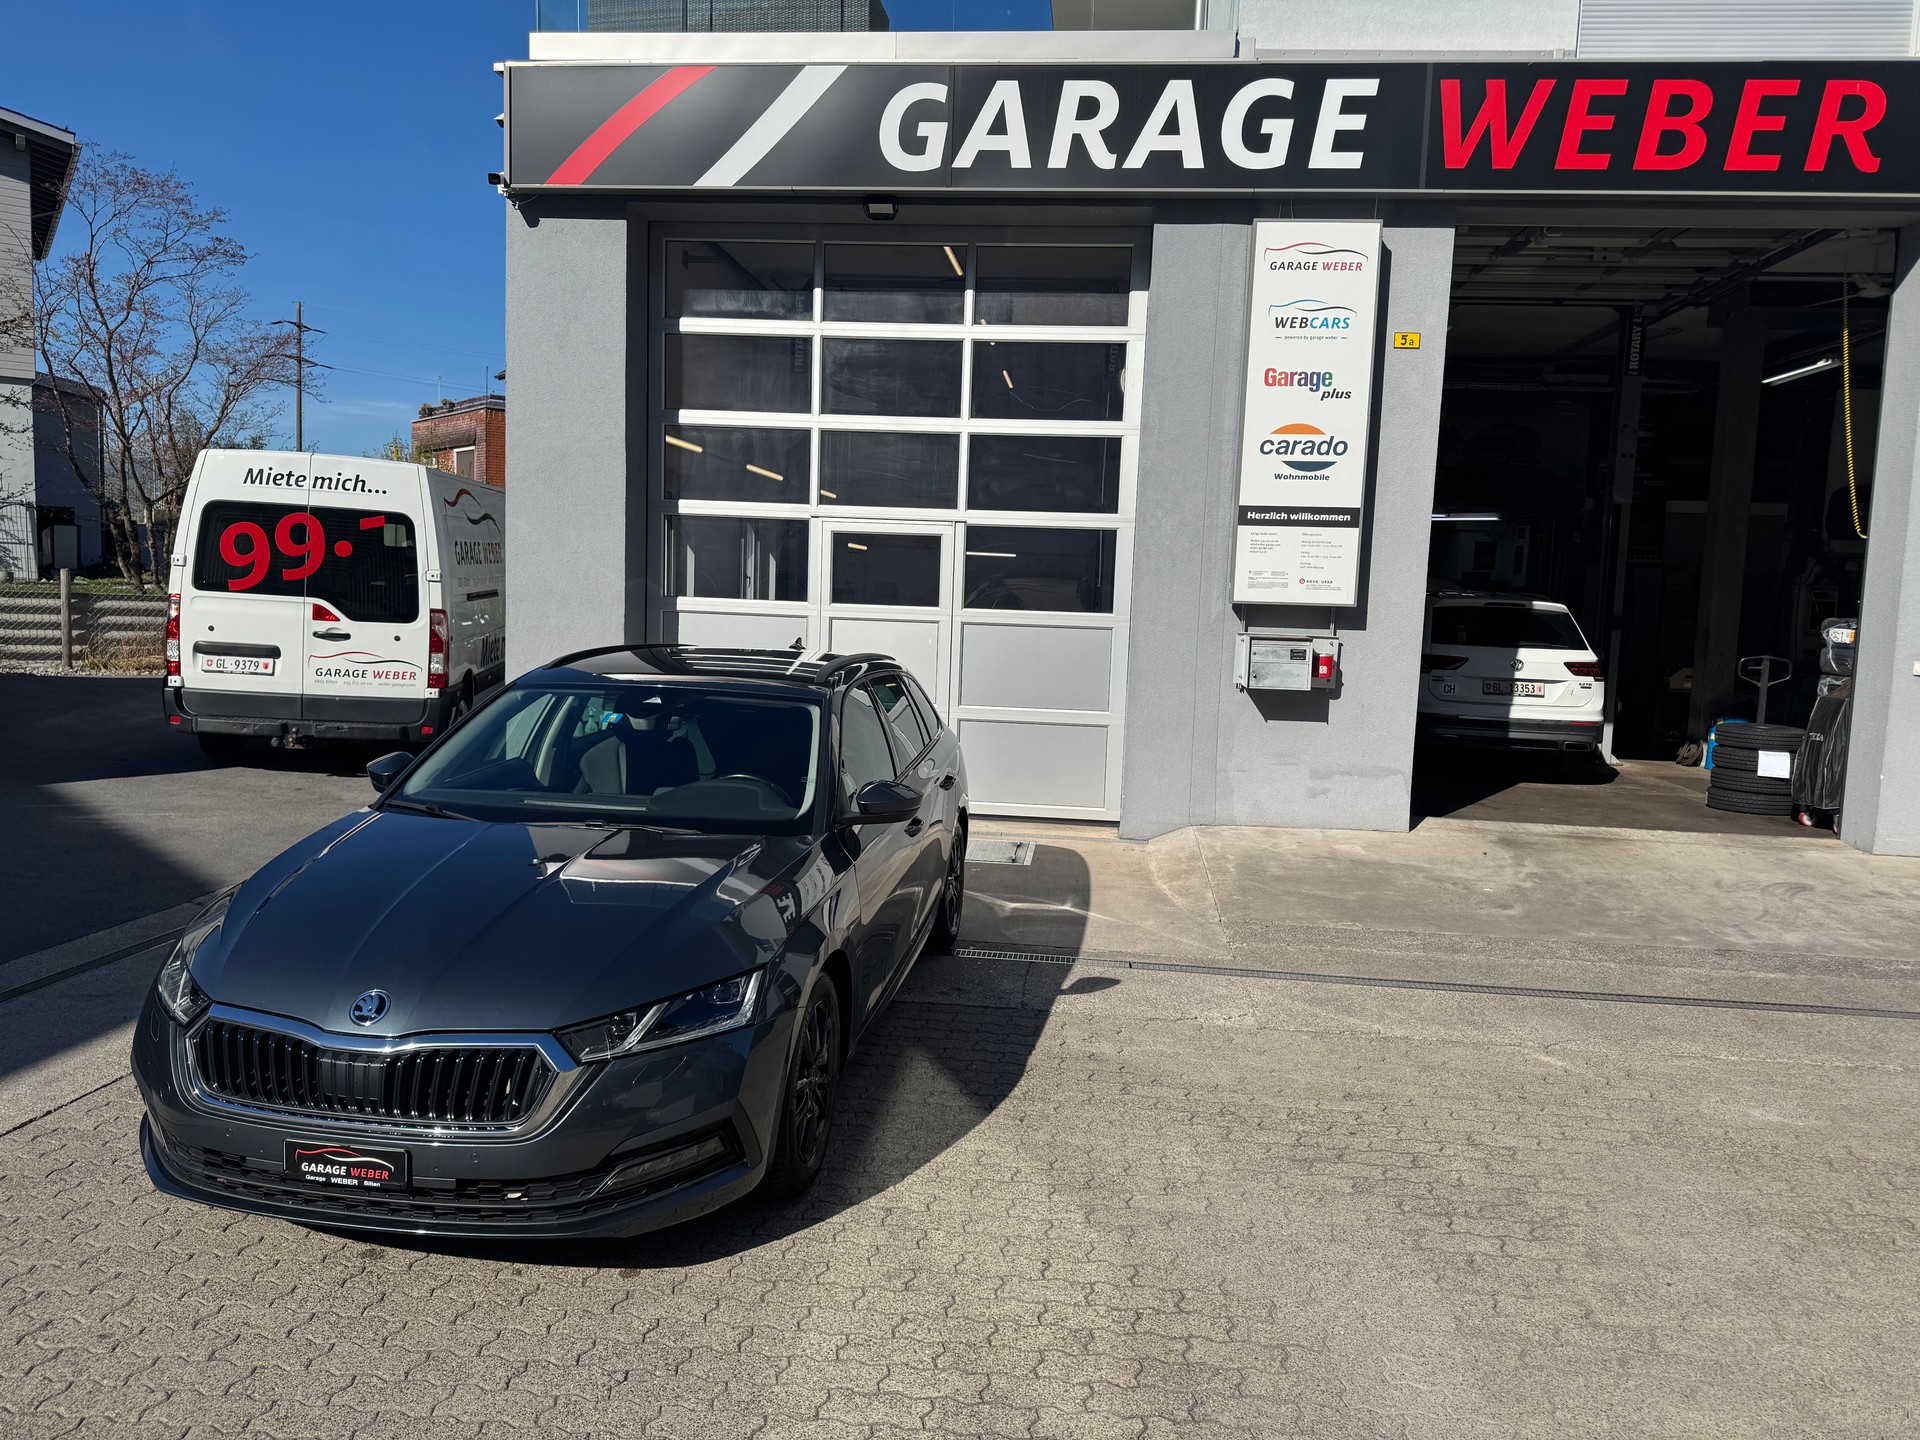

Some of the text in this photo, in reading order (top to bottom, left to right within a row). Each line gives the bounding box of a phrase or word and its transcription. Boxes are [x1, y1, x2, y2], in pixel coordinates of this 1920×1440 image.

[879, 78, 1888, 173] GARAGE WEBER
[1270, 261, 1363, 271] GARAGE WEBER
[1274, 316, 1350, 329] WEBCARS
[1629, 324, 1641, 369] ROTARY
[1264, 367, 1333, 392] Garage
[1320, 388, 1352, 401] plus
[1259, 436, 1348, 456] carado
[243, 467, 387, 494] Miete mich...
[1274, 473, 1330, 481] Wohnmobile
[1247, 511, 1351, 521] Herzlich willkommen
[455, 540, 482, 565] GARAGE
[481, 632, 500, 667] Miete
[315, 667, 417, 681] GARAGE WEBER
[1443, 684, 1456, 694] CH
[301, 1162, 390, 1180] GARAGE WEBER
[305, 1174, 326, 1182] Garage
[331, 1176, 358, 1186] WEBER
